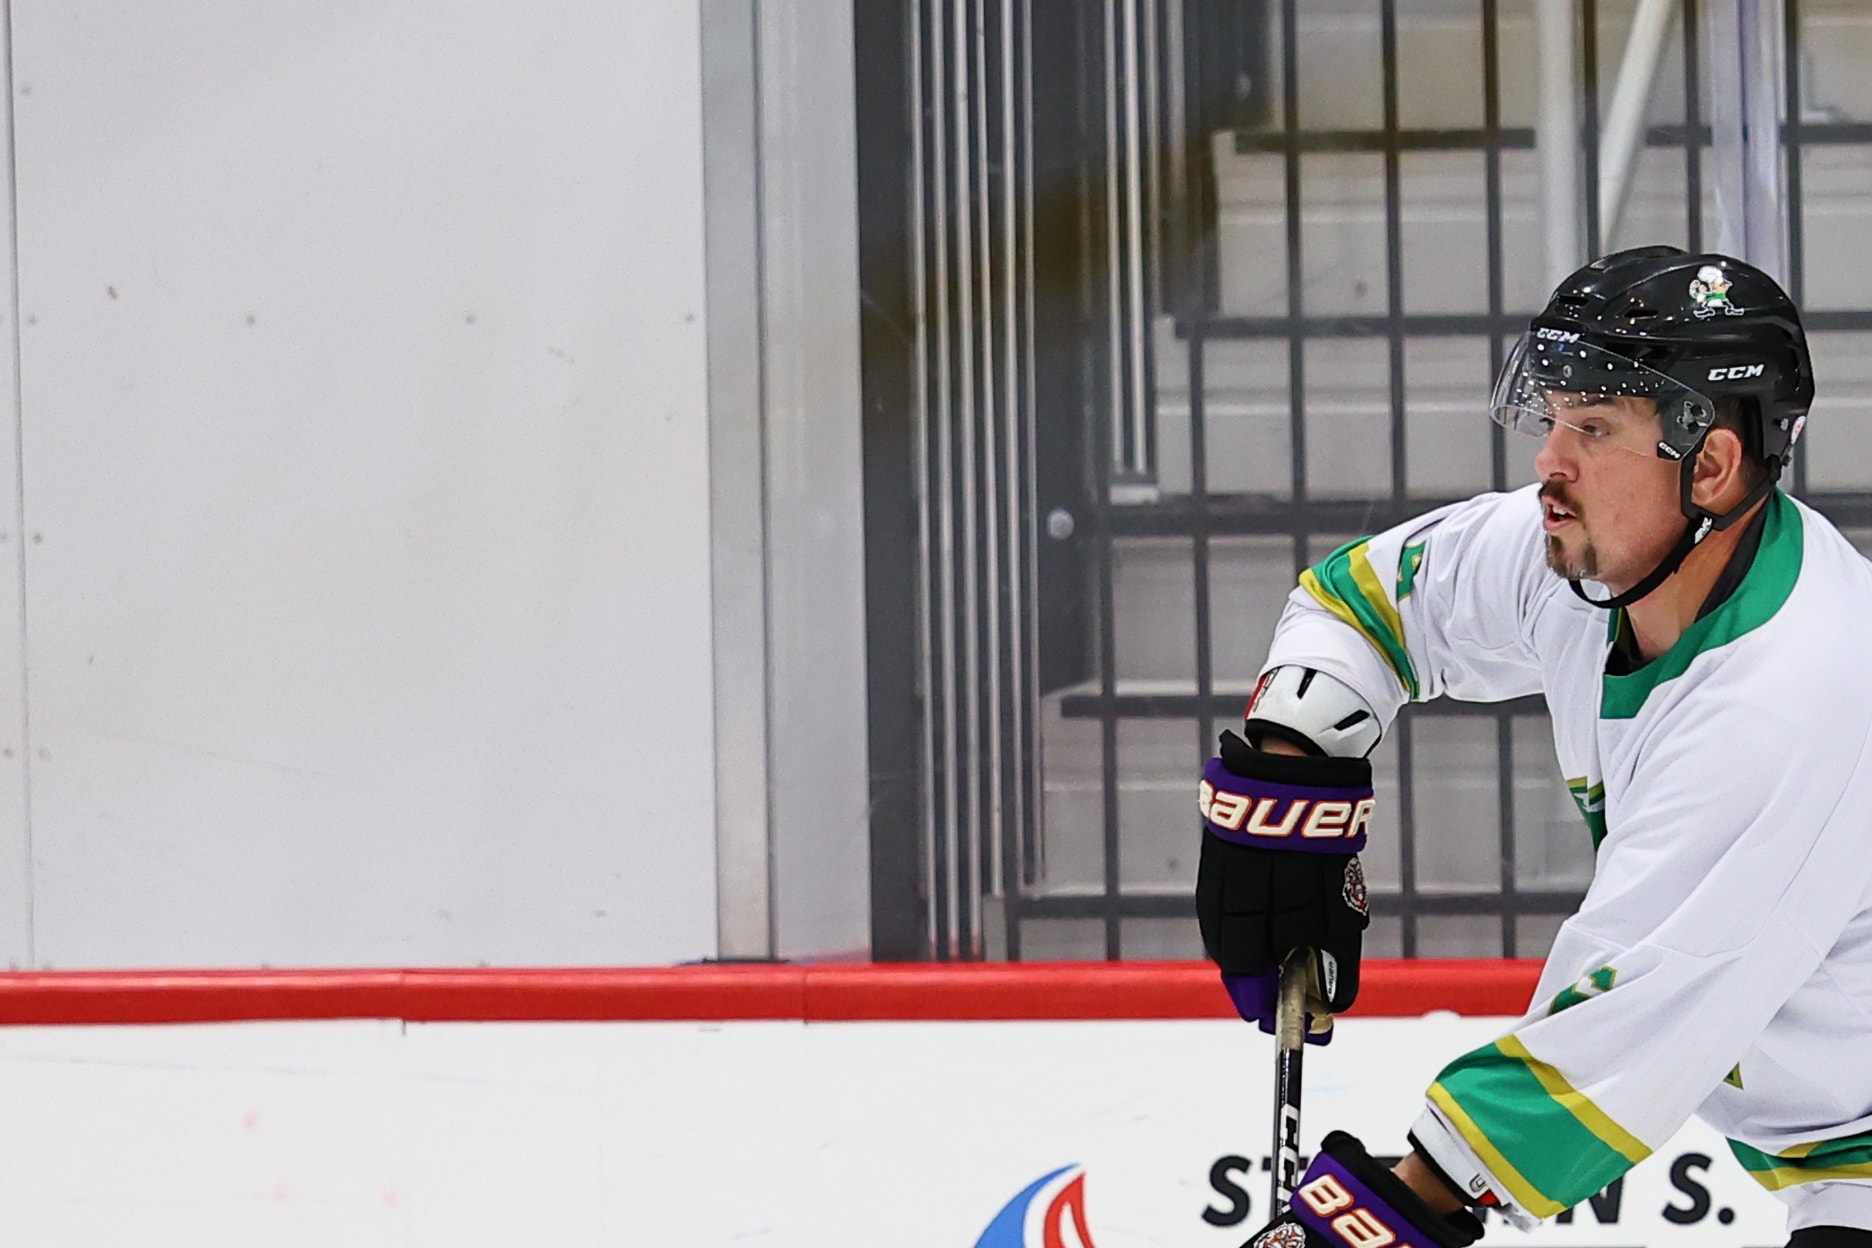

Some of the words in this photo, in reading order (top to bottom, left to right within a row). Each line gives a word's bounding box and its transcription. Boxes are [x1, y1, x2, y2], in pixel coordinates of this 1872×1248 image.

[1536, 327, 1580, 343] CCM
[1707, 364, 1765, 382] CCM
[1658, 441, 1681, 459] CCM
[1277, 1103, 1300, 1214] CC
[1661, 1152, 1735, 1225] S.
